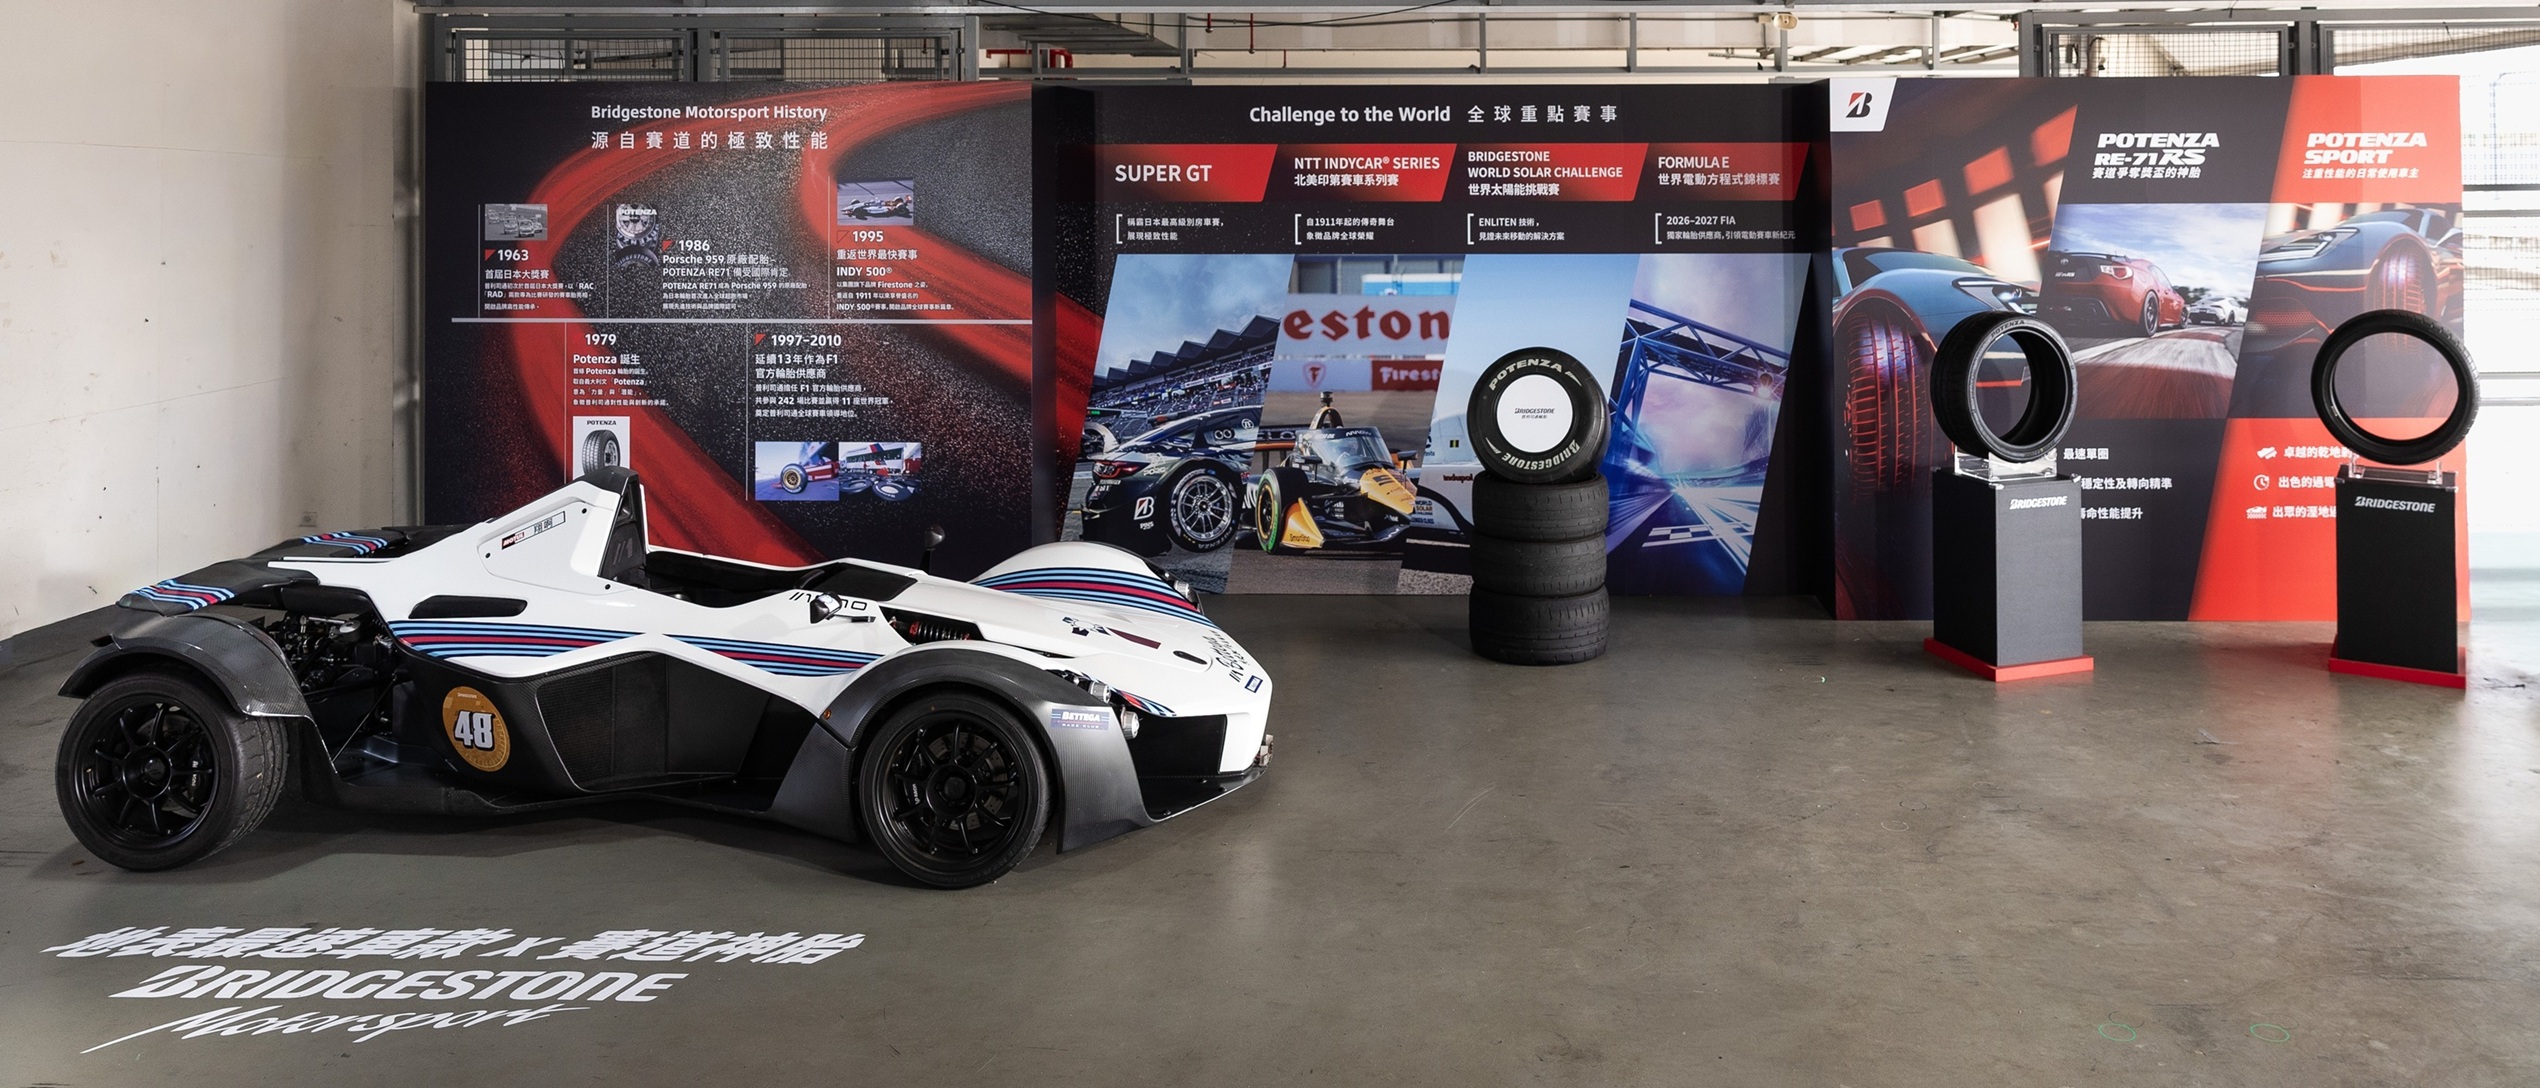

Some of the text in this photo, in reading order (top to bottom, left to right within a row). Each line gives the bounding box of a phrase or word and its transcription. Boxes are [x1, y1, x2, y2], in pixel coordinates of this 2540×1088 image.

[591, 105, 827, 121] Bridgestone Motorsport History
[1250, 106, 1450, 126] Challenge to the World
[1467, 105, 1618, 123] 全球重點賽事
[591, 131, 828, 149] 源自賽道的極致性能
[2097, 133, 2220, 148] POTENZA
[2306, 132, 2428, 148] POTENZA
[1294, 156, 1440, 170] NTT INDYCAR® SERIES
[1468, 151, 1550, 162] BRIDGESTONE
[1658, 156, 1730, 169] FORMULA E
[2303, 149, 2394, 165] SPORT
[1115, 164, 1212, 182] SUPER GT
[1468, 166, 1623, 178] WORLD SOLAR CHALLENGE
[2092, 167, 2202, 179] 賽道爭奪獎盃的神胎
[2302, 168, 2419, 179] 注重性能的日常使用車主
[1294, 173, 1399, 187] 北美印第賽車系列賽
[1658, 173, 1780, 186] 世界電動方程式錦標賽
[1468, 183, 1560, 196] 世界太陽能挑戰賽
[1479, 218, 1517, 227] ENLITEN
[1720, 216, 1736, 225] FIA
[852, 231, 884, 242] 1995
[1127, 231, 1178, 241] 展現極致性能
[679, 240, 710, 251] 1986
[497, 249, 529, 261] 1963
[663, 254, 703, 264] Porsche
[705, 254, 725, 264] 959
[836, 249, 918, 260] 重返世界最快賽事
[485, 269, 549, 280] 首屆日本大獎賽
[663, 267, 788, 278] POTENZA RE71 備受國際肯定
[836, 266, 892, 276] INDY 500®
[663, 282, 698, 290] POTENZA
[700, 282, 717, 290] RE71
[731, 282, 761, 290] Porsche
[762, 282, 777, 290] 959
[1991, 319, 2026, 338] POTENZA
[585, 334, 617, 345] 1979
[573, 354, 641, 365] Potenza 誕生
[755, 368, 827, 379] 官方輪胎供應商
[1489, 358, 1562, 391] POTENZA
[800, 384, 810, 392] F1
[778, 397, 795, 405] 242
[842, 397, 850, 405] 11
[1502, 439, 1581, 470] BRIDGESTONE
[2009, 495, 2068, 510] BRIDGESTONE
[2354, 495, 2436, 513] BRIDGESTONE
[454, 710, 494, 749] 48
[536, 928, 866, 965] 賽道神胎
[108, 965, 690, 1002] BRIDGESTONE
[80, 1003, 591, 1054] Motorsport
